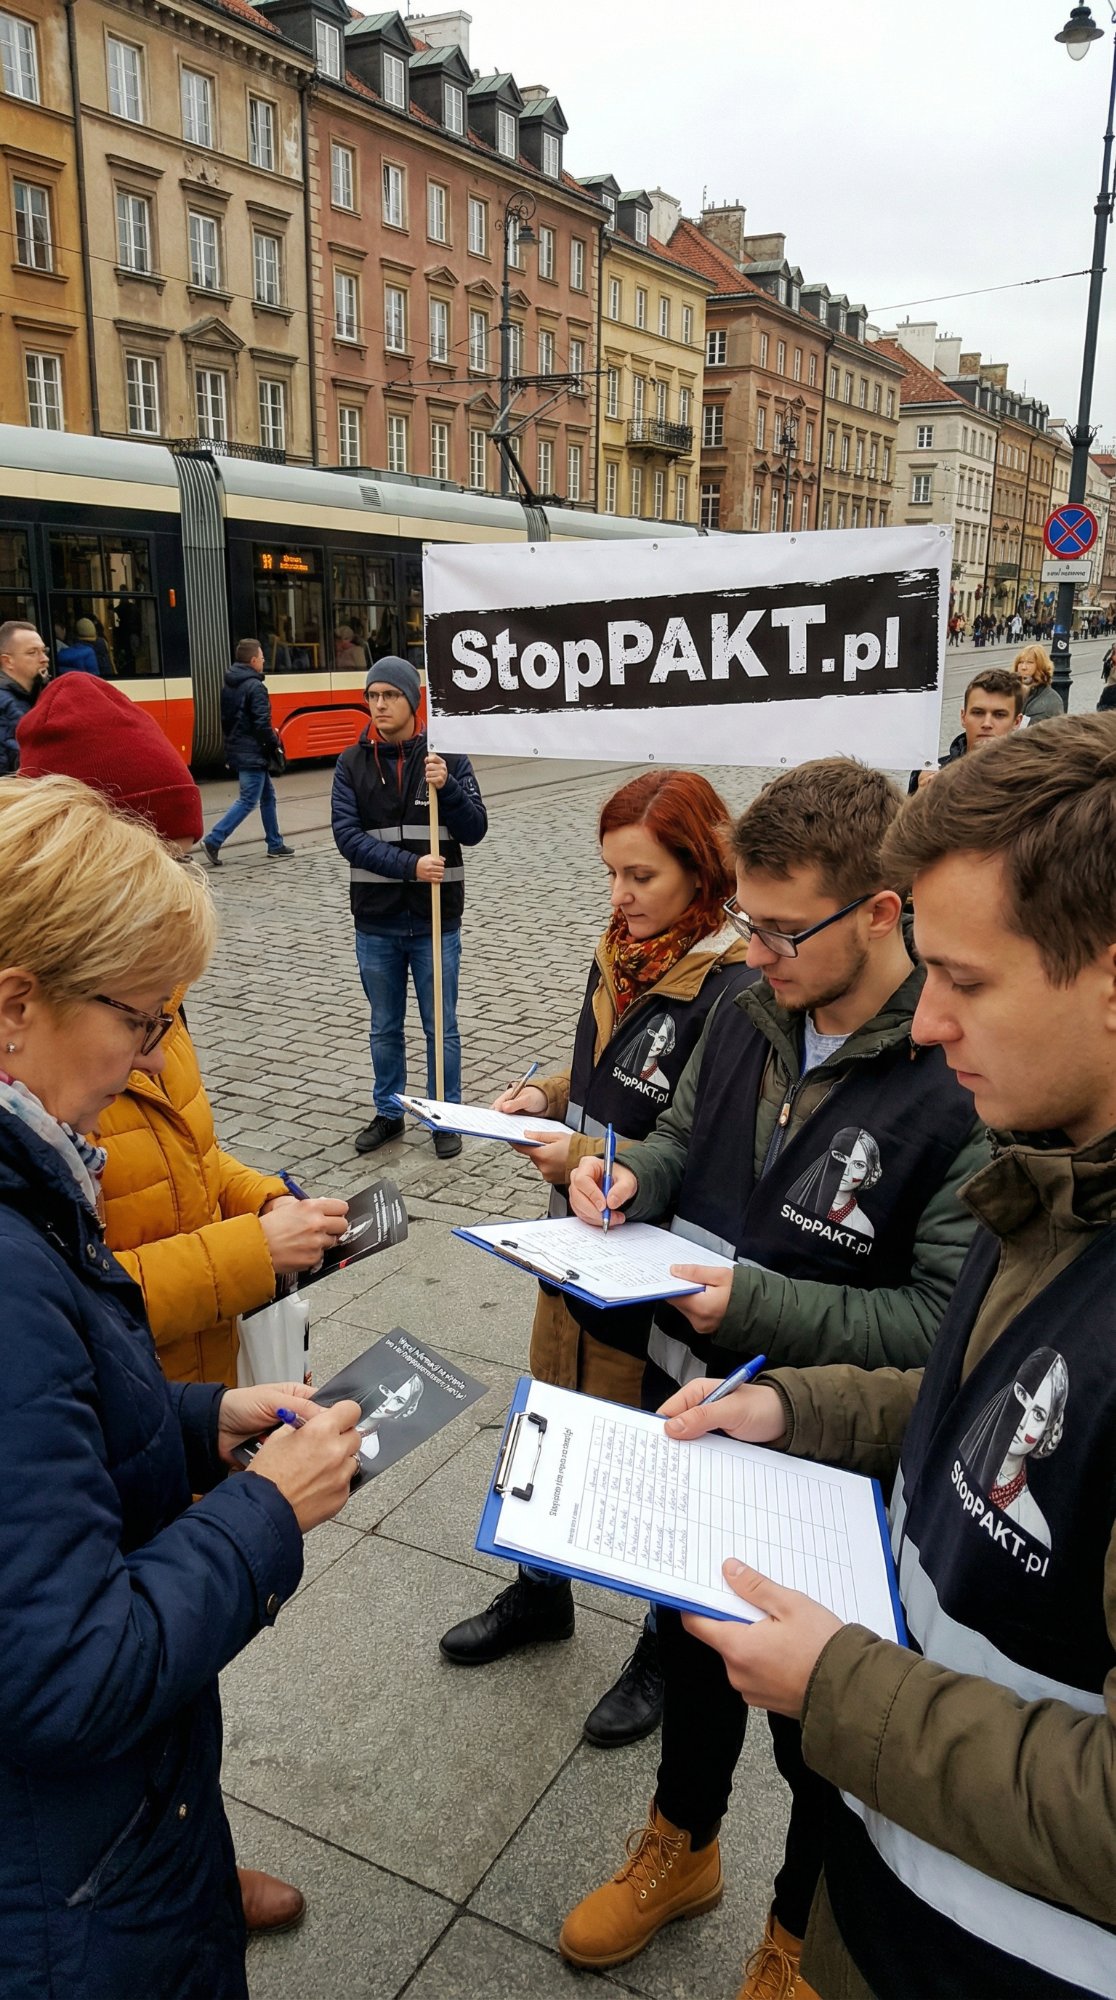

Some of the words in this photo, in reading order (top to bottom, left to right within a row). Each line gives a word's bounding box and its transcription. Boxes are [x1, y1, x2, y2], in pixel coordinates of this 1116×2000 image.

[451, 604, 900, 701] StopPAKT.pl
[612, 1066, 669, 1104] StopPAKT.pl
[781, 1204, 872, 1255] StopPAKT.pl
[950, 1460, 1050, 1577] StopPAKT.pl
